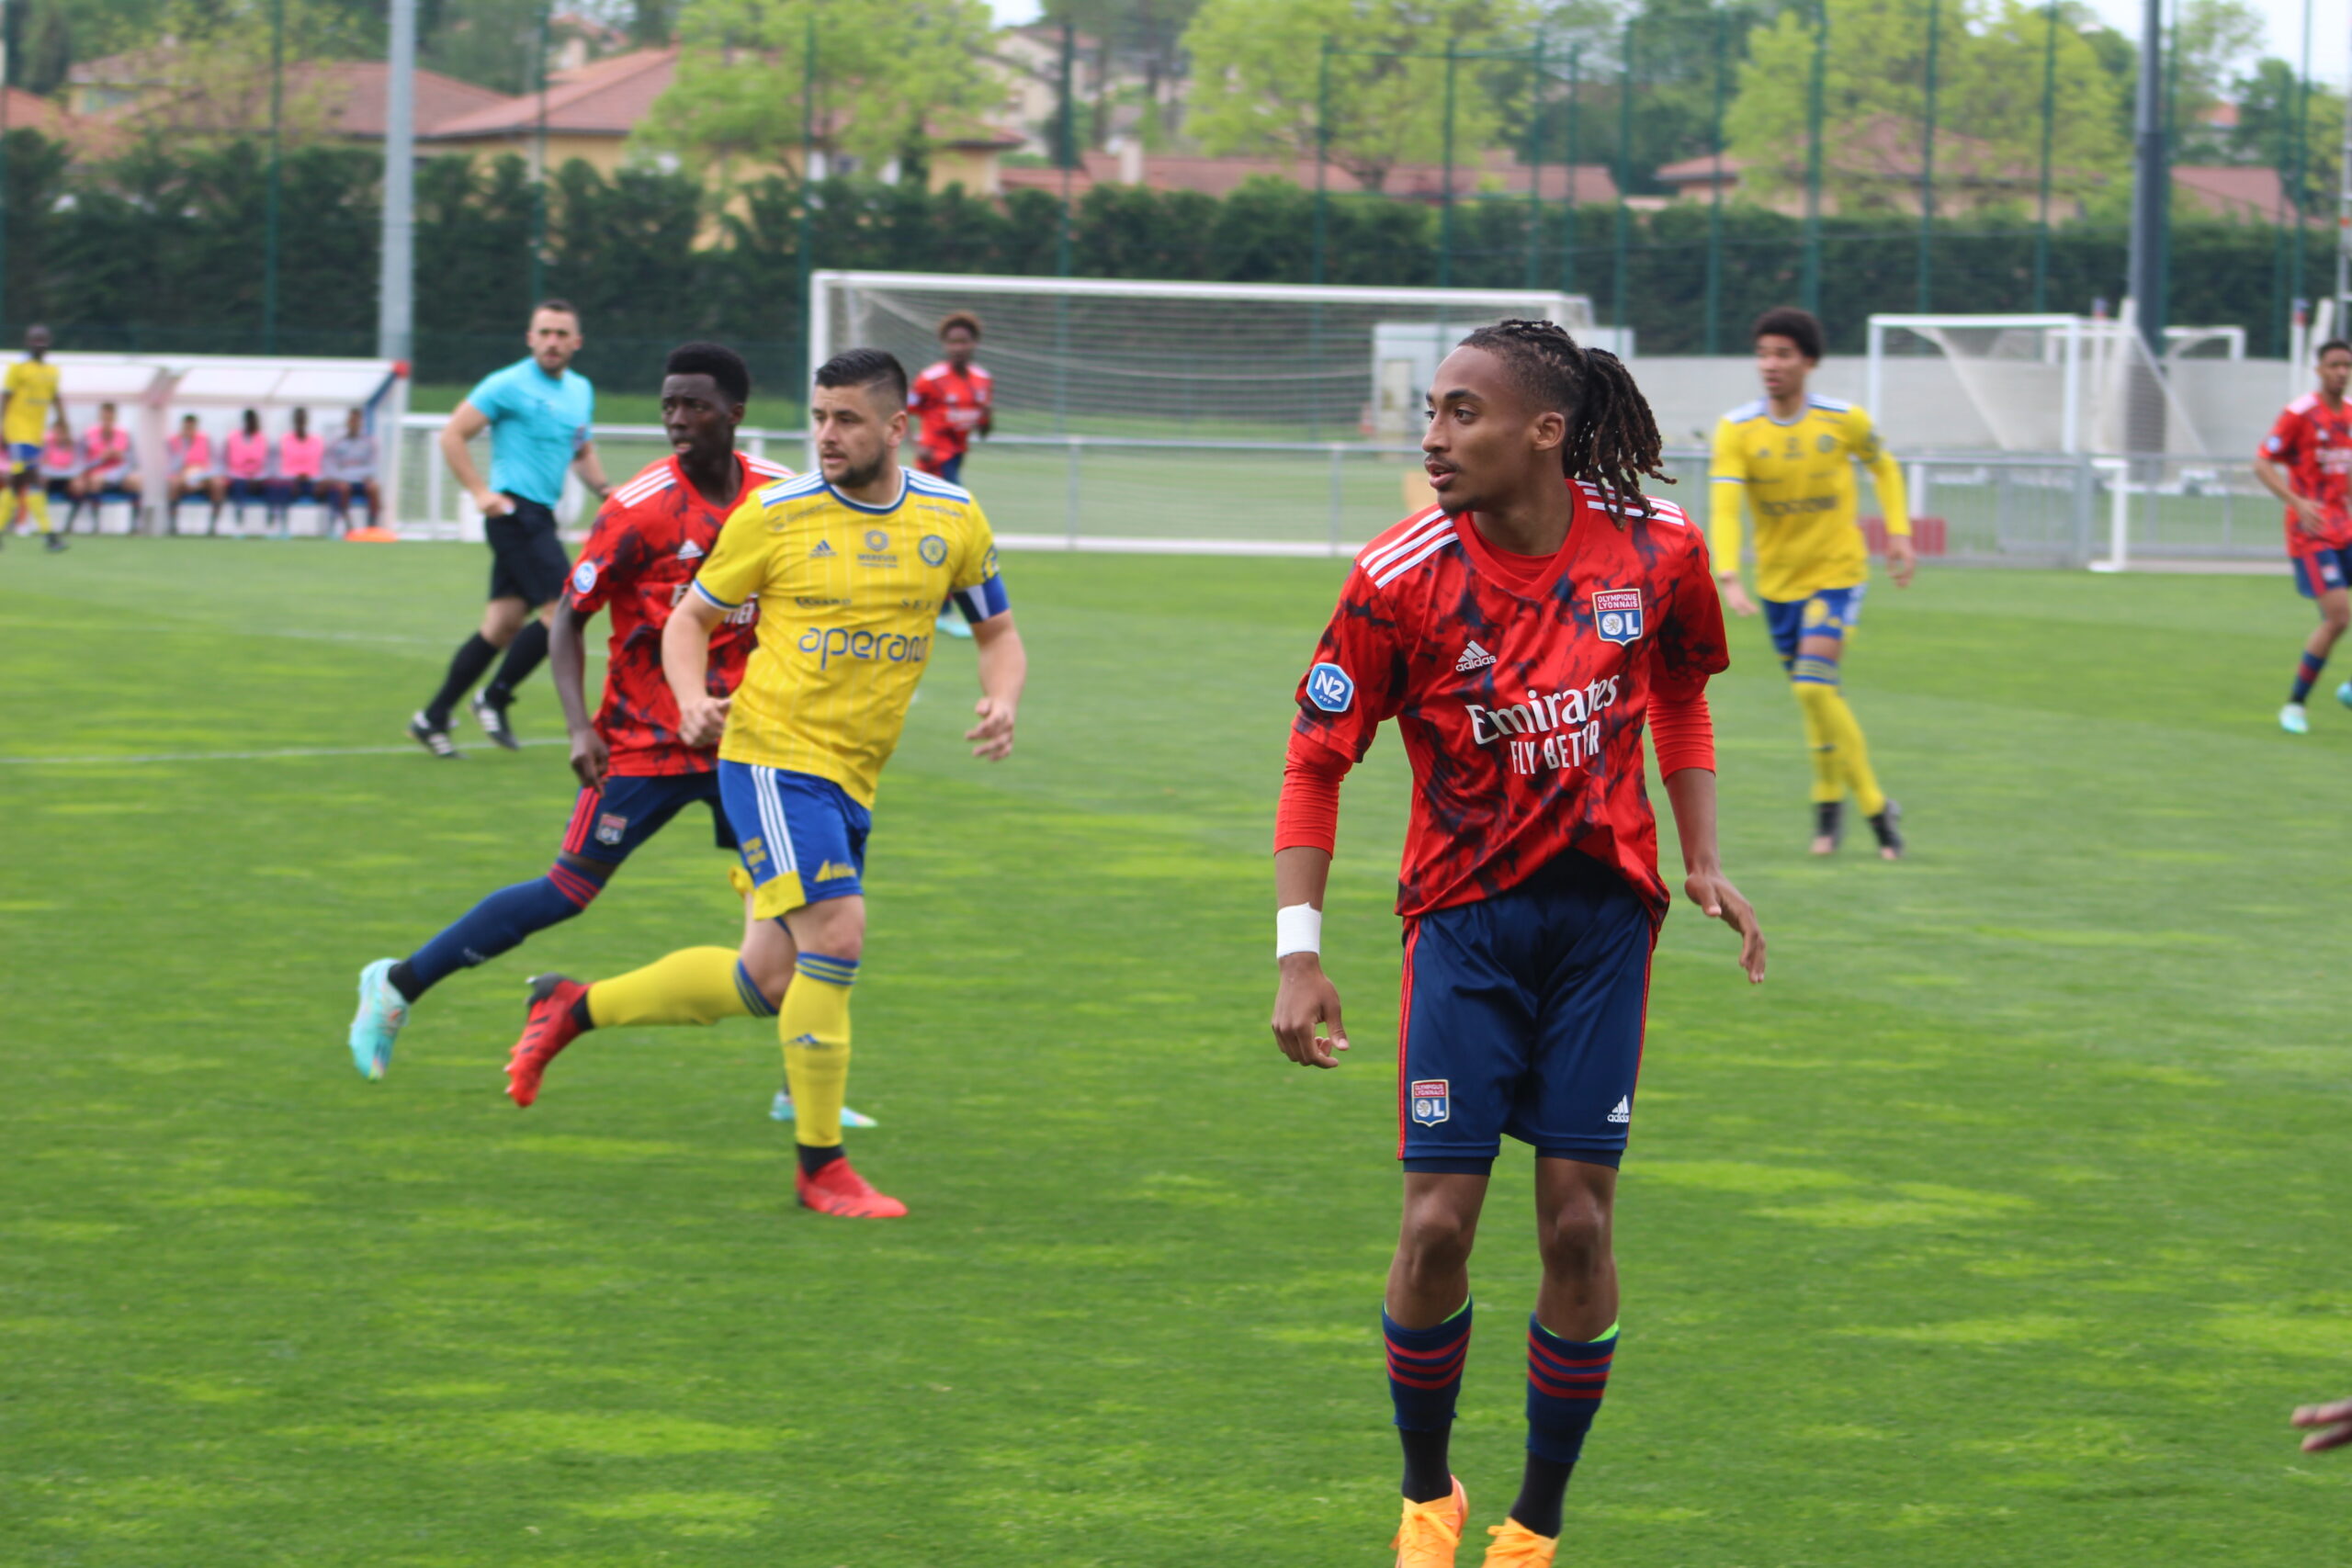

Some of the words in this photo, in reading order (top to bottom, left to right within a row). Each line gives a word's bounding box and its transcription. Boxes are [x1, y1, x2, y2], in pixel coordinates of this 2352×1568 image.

[1597, 593, 1638, 603] OLYMPIQUE
[1599, 601, 1638, 610] LYONNAIS
[1455, 654, 1497, 672] adidas
[1315, 670, 1345, 703] N2
[1464, 674, 1620, 745] Emirates
[1510, 740, 1535, 775] FLY
[1544, 720, 1600, 770] BETR
[1607, 1112, 1630, 1123] adida
